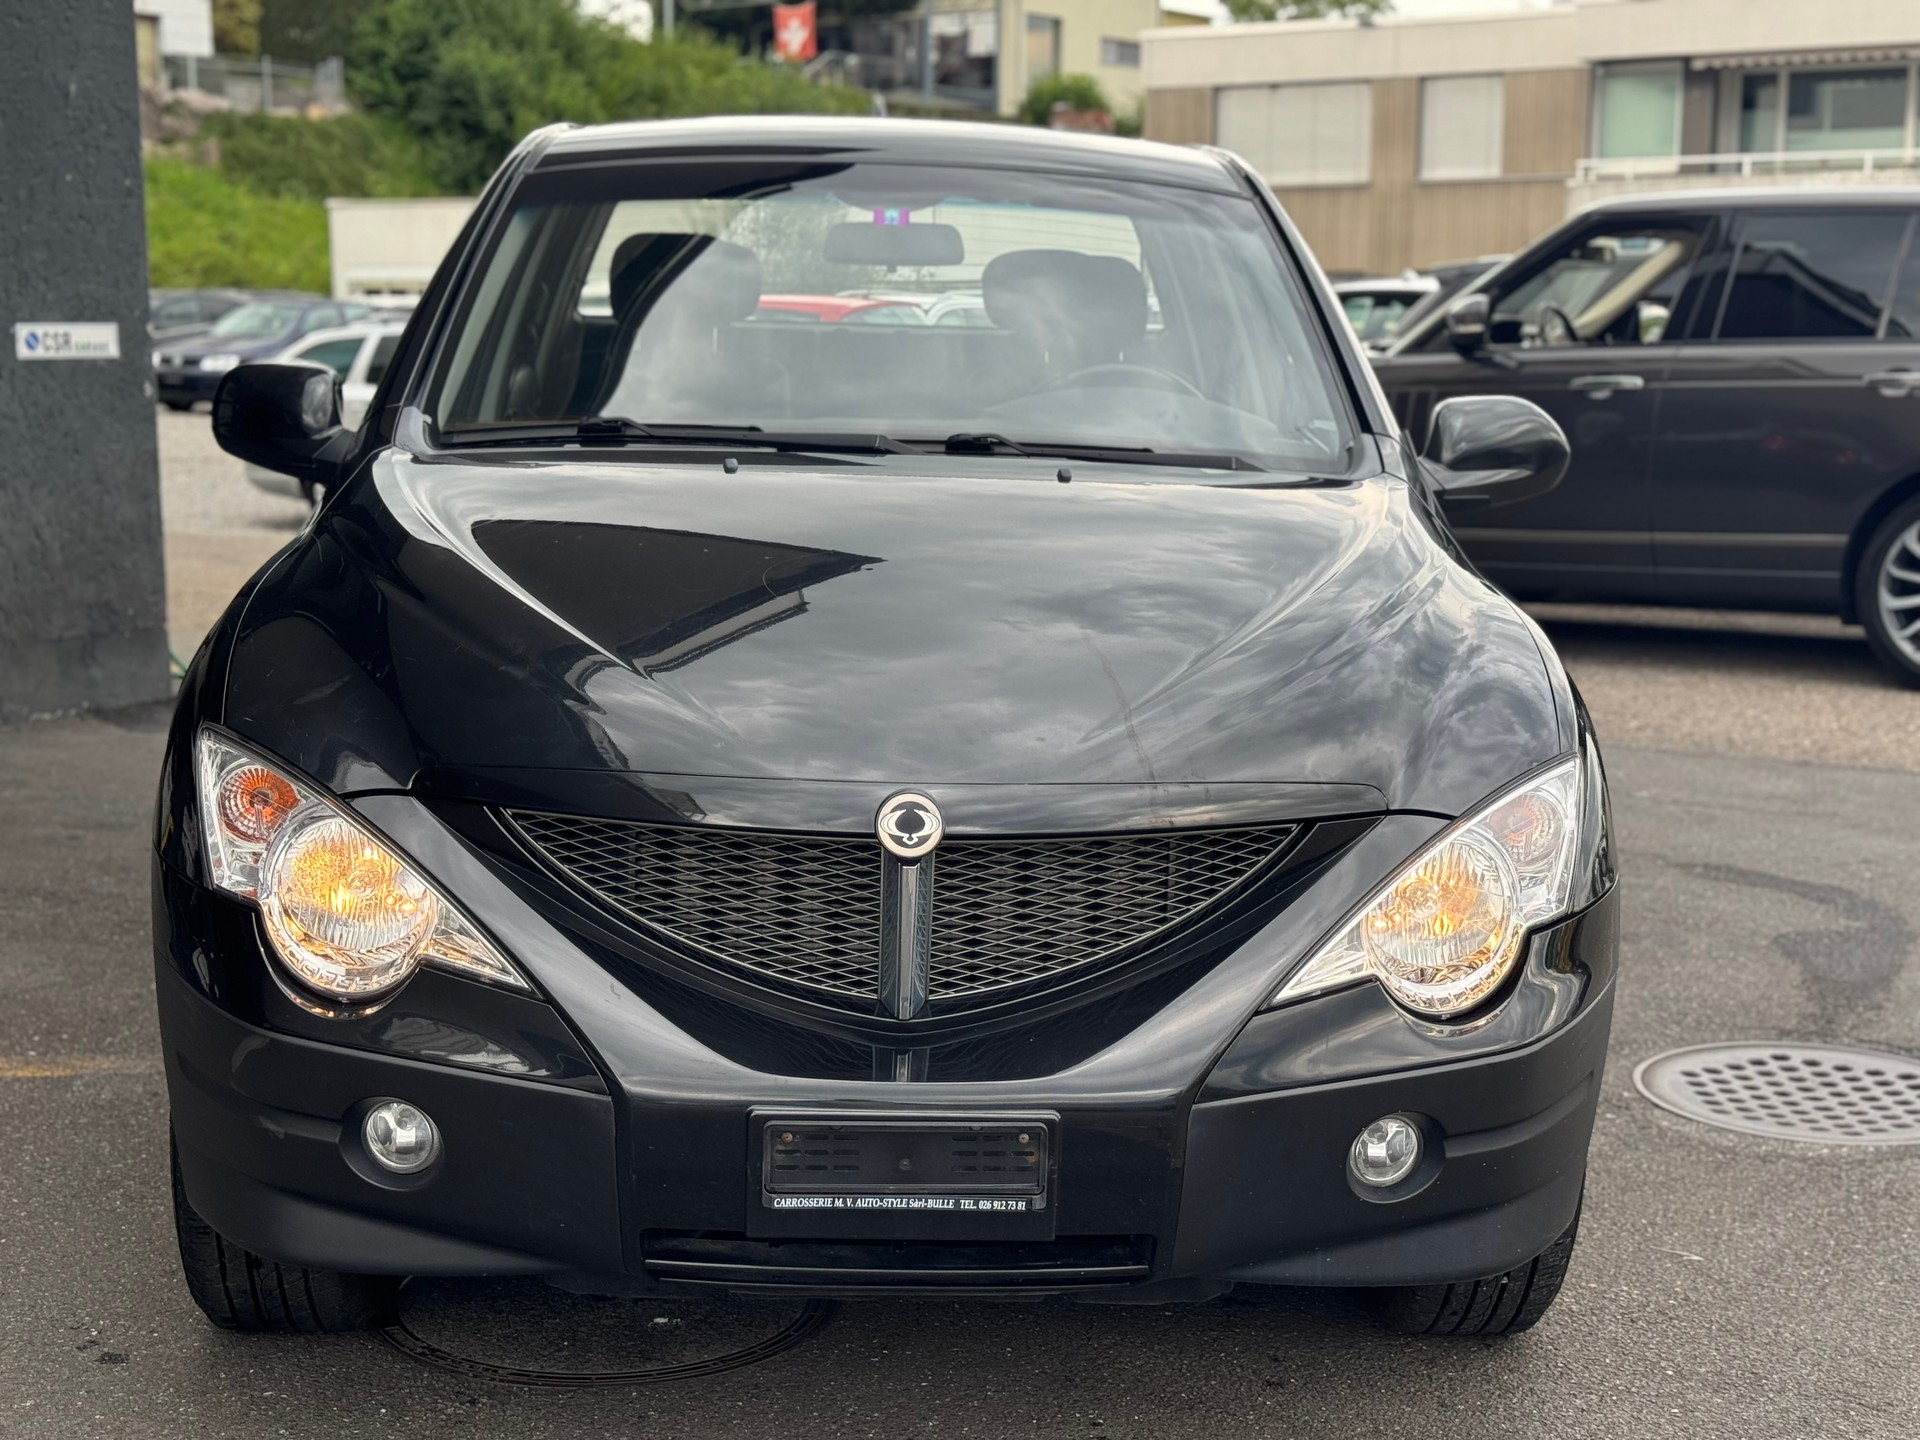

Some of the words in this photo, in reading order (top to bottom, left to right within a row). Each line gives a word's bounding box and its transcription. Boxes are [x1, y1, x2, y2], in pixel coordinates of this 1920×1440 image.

[774, 1198, 832, 1207] CARROSSERIE
[833, 1198, 844, 1207] M.
[847, 1198, 854, 1207] V.
[855, 1198, 909, 1208] AUTO-STYLE
[960, 1200, 976, 1209] TEL.
[978, 1200, 992, 1209] 026
[993, 1200, 1006, 1210] 912
[1007, 1201, 1016, 1210] 73
[1017, 1201, 1026, 1211] 81
